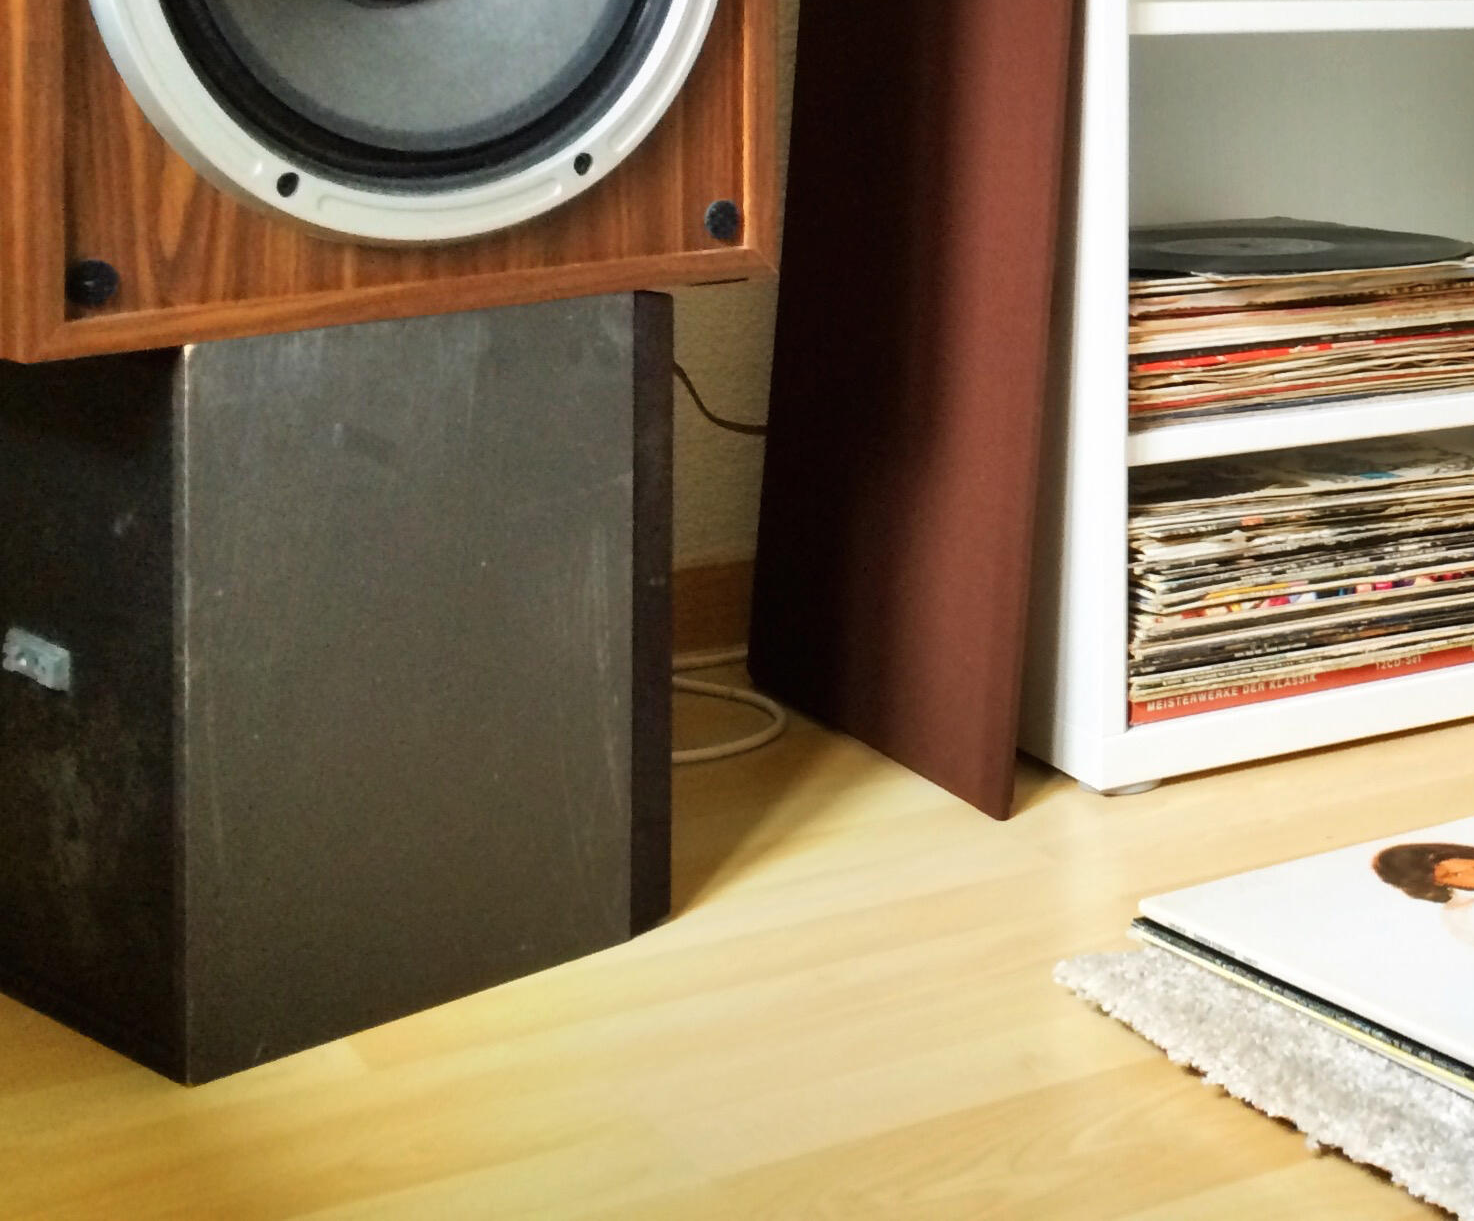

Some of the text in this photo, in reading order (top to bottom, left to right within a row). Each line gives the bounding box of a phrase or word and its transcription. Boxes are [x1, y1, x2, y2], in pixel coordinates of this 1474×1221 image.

[1146, 673, 1317, 712] MEISTERWERKE DER KLASSIK
